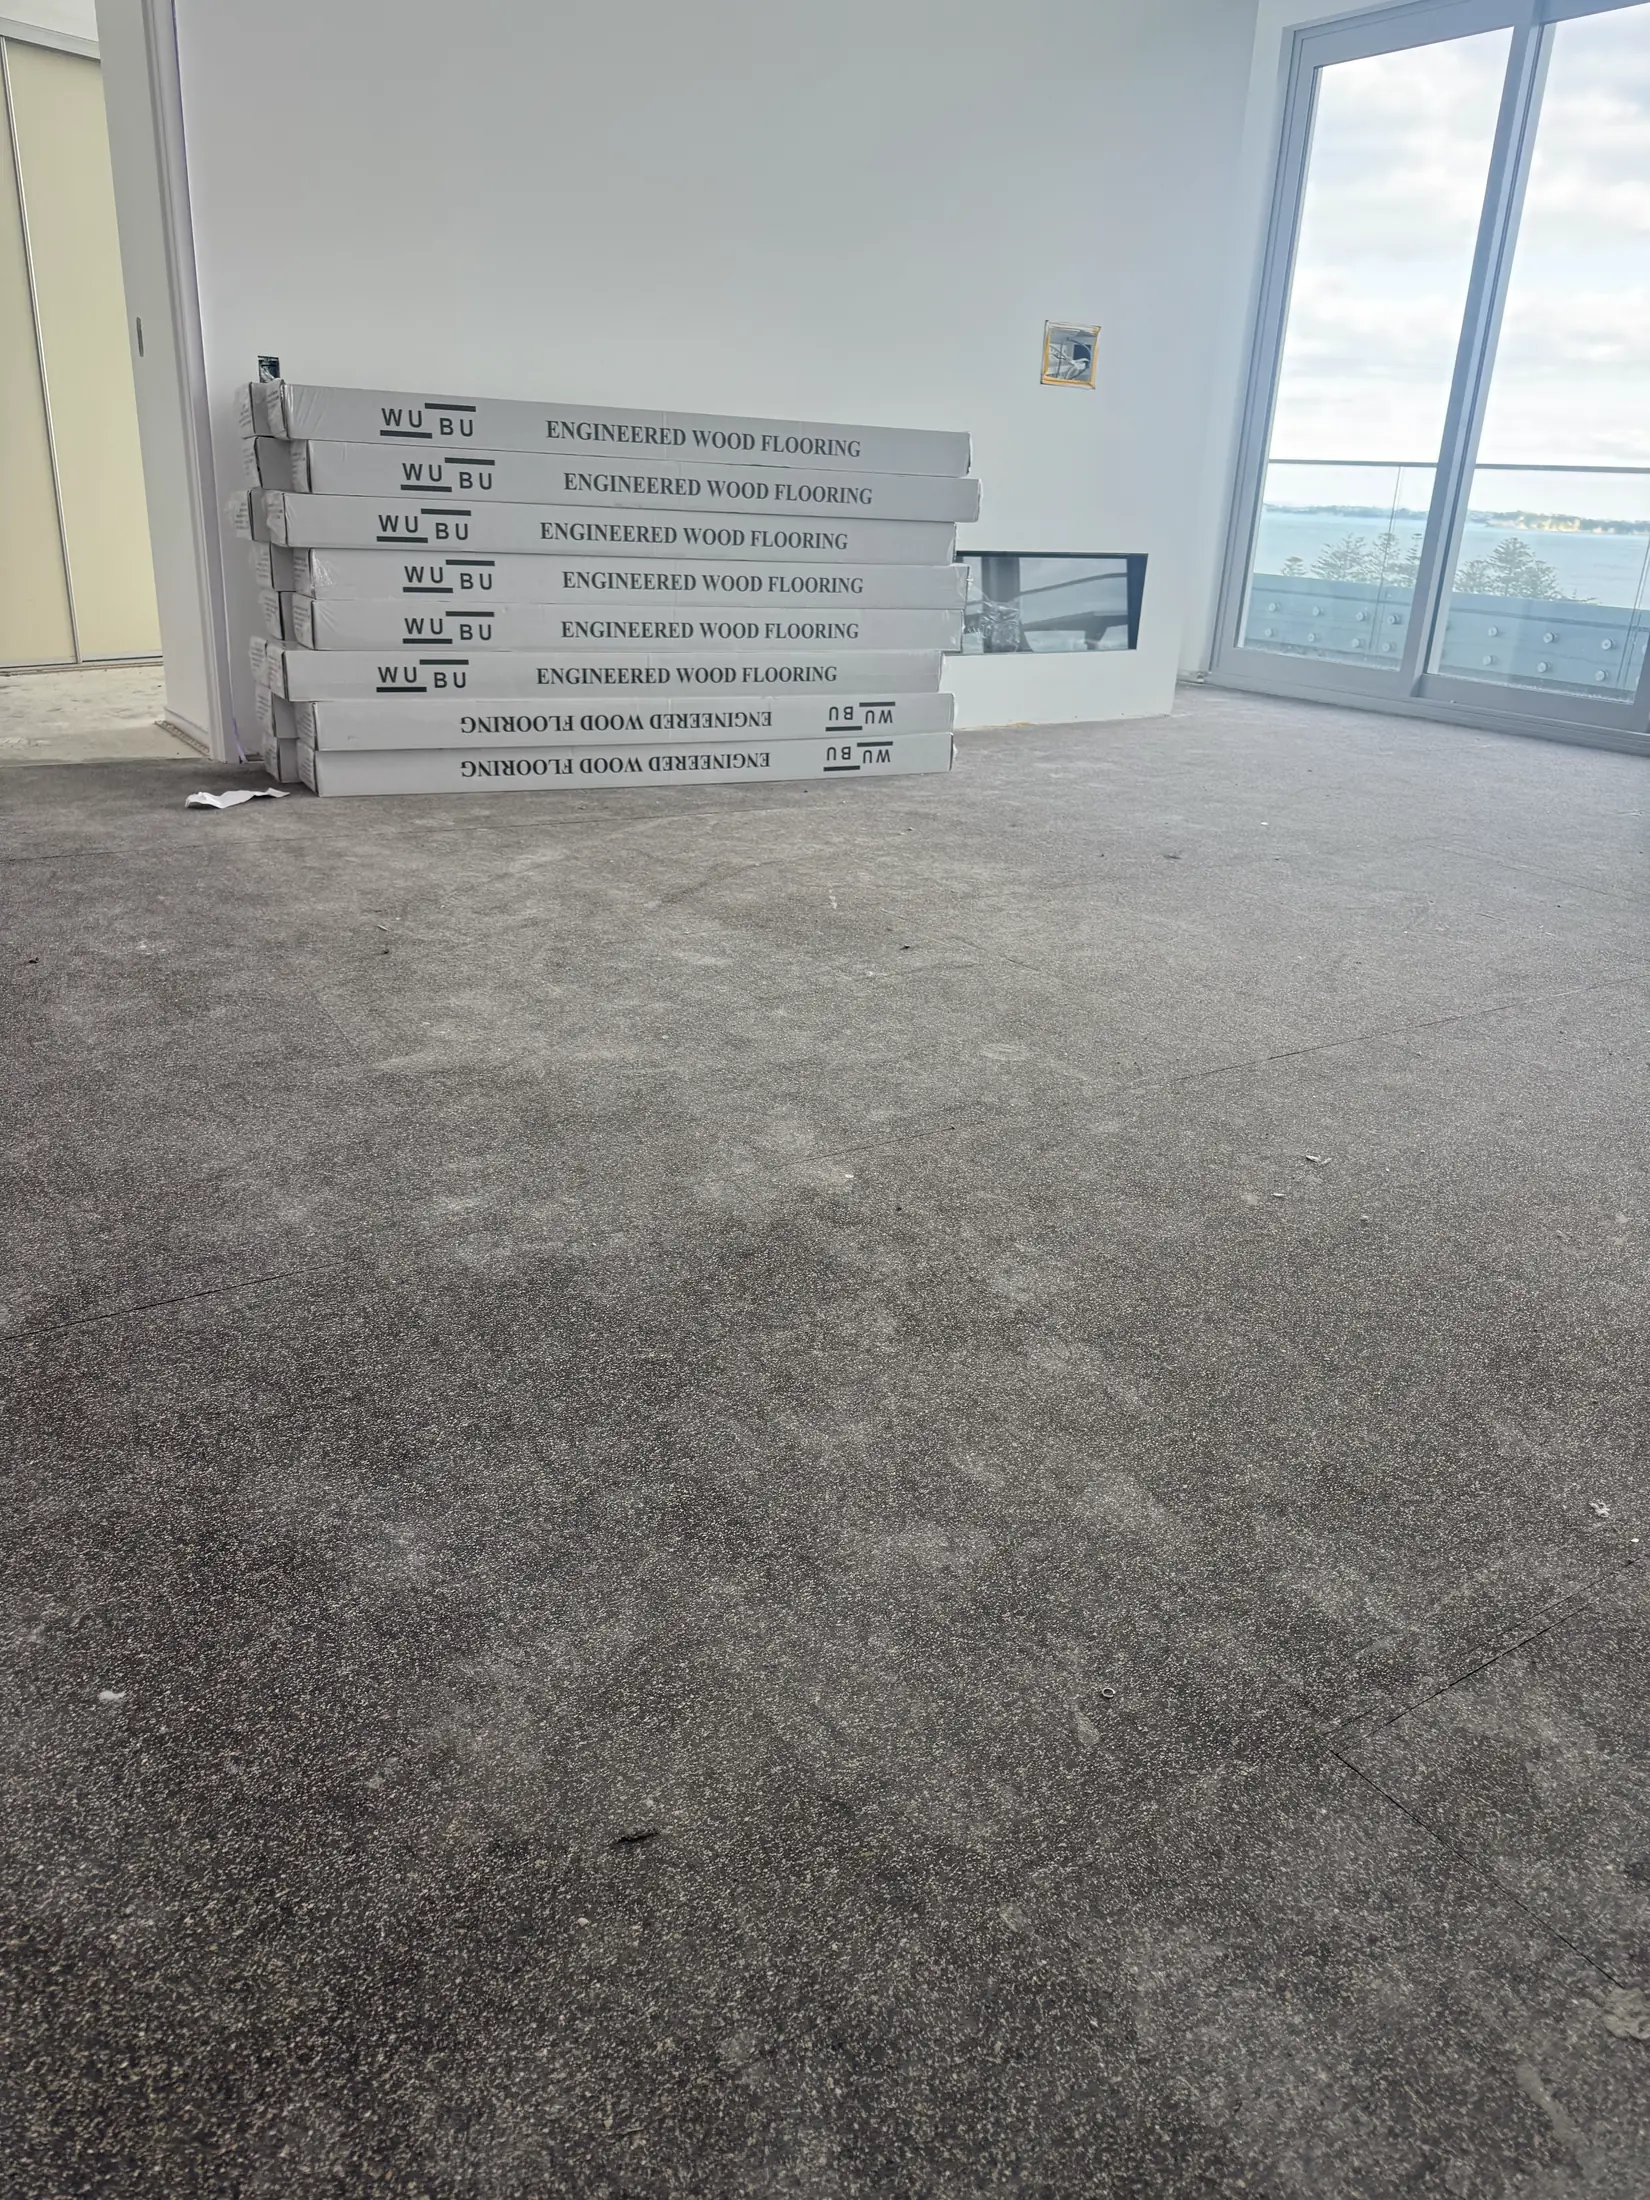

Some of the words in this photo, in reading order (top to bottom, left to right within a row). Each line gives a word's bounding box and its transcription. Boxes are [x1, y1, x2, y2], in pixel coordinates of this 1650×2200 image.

[381, 408, 422, 428] WU
[440, 418, 473, 437] BU
[546, 420, 686, 445] ENGINEERED
[692, 430, 755, 450] WOOD
[761, 435, 860, 457] FLOORING
[402, 463, 442, 482] WU
[459, 472, 492, 490] BU
[564, 473, 701, 496] ENGINEERED
[707, 480, 769, 499] WOOD
[775, 484, 872, 504] FLOORING
[378, 515, 418, 533] WU
[435, 522, 468, 540] BU
[540, 522, 677, 543] ENGINEERED
[683, 528, 745, 546] WOOD
[750, 530, 847, 549] FLOORING
[404, 566, 443, 584] WU
[460, 573, 492, 590] BU
[562, 571, 696, 590] ENGINEERED
[702, 575, 762, 592] WOOD
[768, 576, 863, 593] FLOORING
[404, 618, 443, 635] WU
[460, 624, 491, 641] BU
[561, 621, 694, 638] ENGINEERED
[699, 623, 759, 639] WOOD
[764, 623, 858, 639] FLOORING
[377, 667, 417, 683] WU
[434, 672, 466, 688] BU
[537, 668, 670, 684] ENGINEERED
[676, 667, 736, 683] WOOD
[742, 666, 837, 682] FLOORING
[580, 714, 644, 731] WOOD
[650, 712, 772, 729] ENGINEERED
[829, 706, 853, 721] BU
[865, 710, 893, 724] WU
[460, 716, 574, 733] FLOORING
[648, 753, 770, 771] ENGINEERED
[827, 746, 851, 761] BU
[863, 749, 890, 763] WU
[460, 759, 574, 777] FLOORING
[580, 757, 643, 773] WOOD
